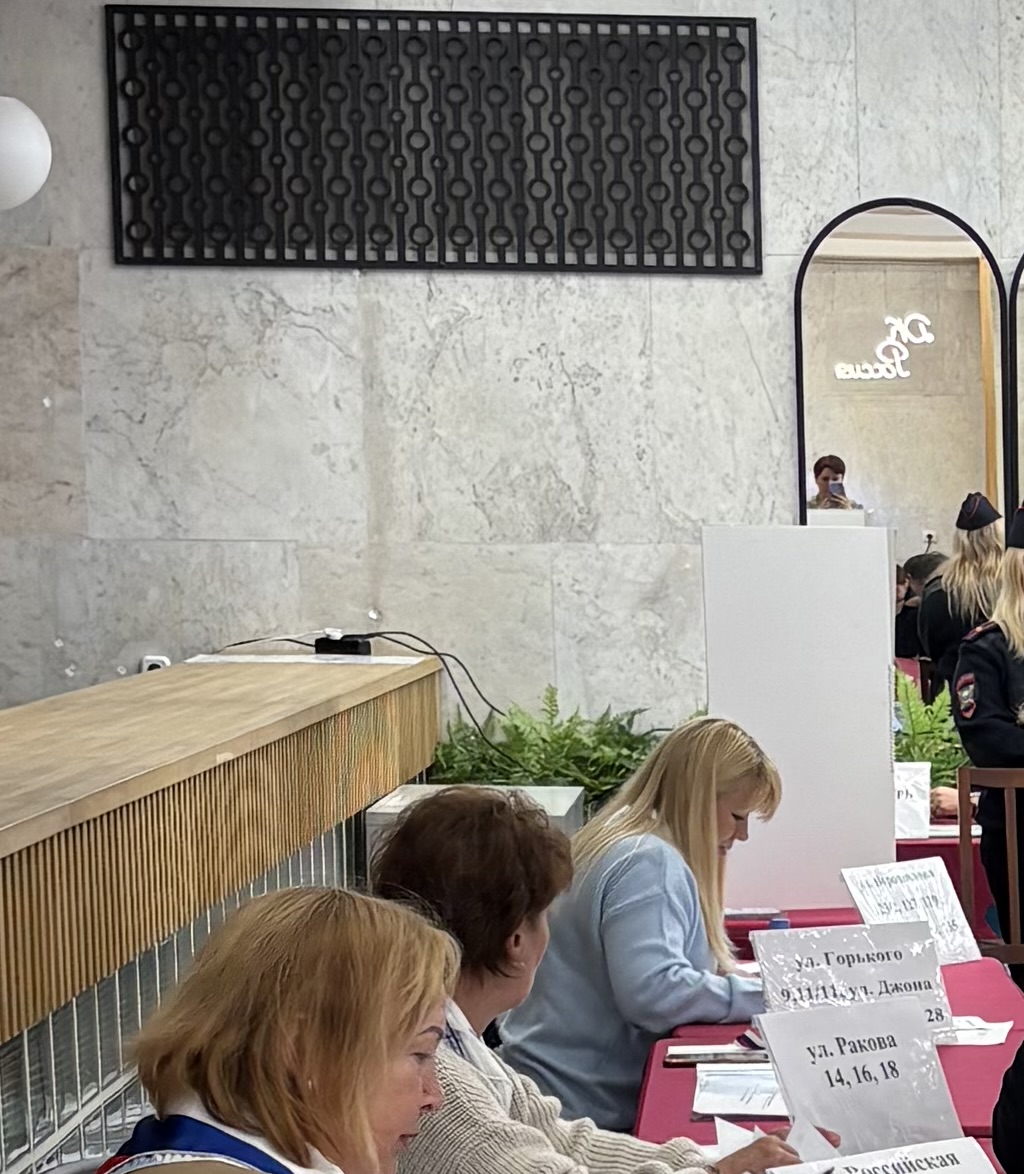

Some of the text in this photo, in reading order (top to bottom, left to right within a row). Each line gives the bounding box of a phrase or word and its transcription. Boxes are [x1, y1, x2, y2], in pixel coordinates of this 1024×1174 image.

[794, 950, 903, 972] ул. Горького
[878, 979, 933, 996] Джона
[924, 1008, 945, 1023] 28
[806, 1034, 898, 1065] ул. Ракова
[824, 1060, 900, 1089] 14, 16, 18
